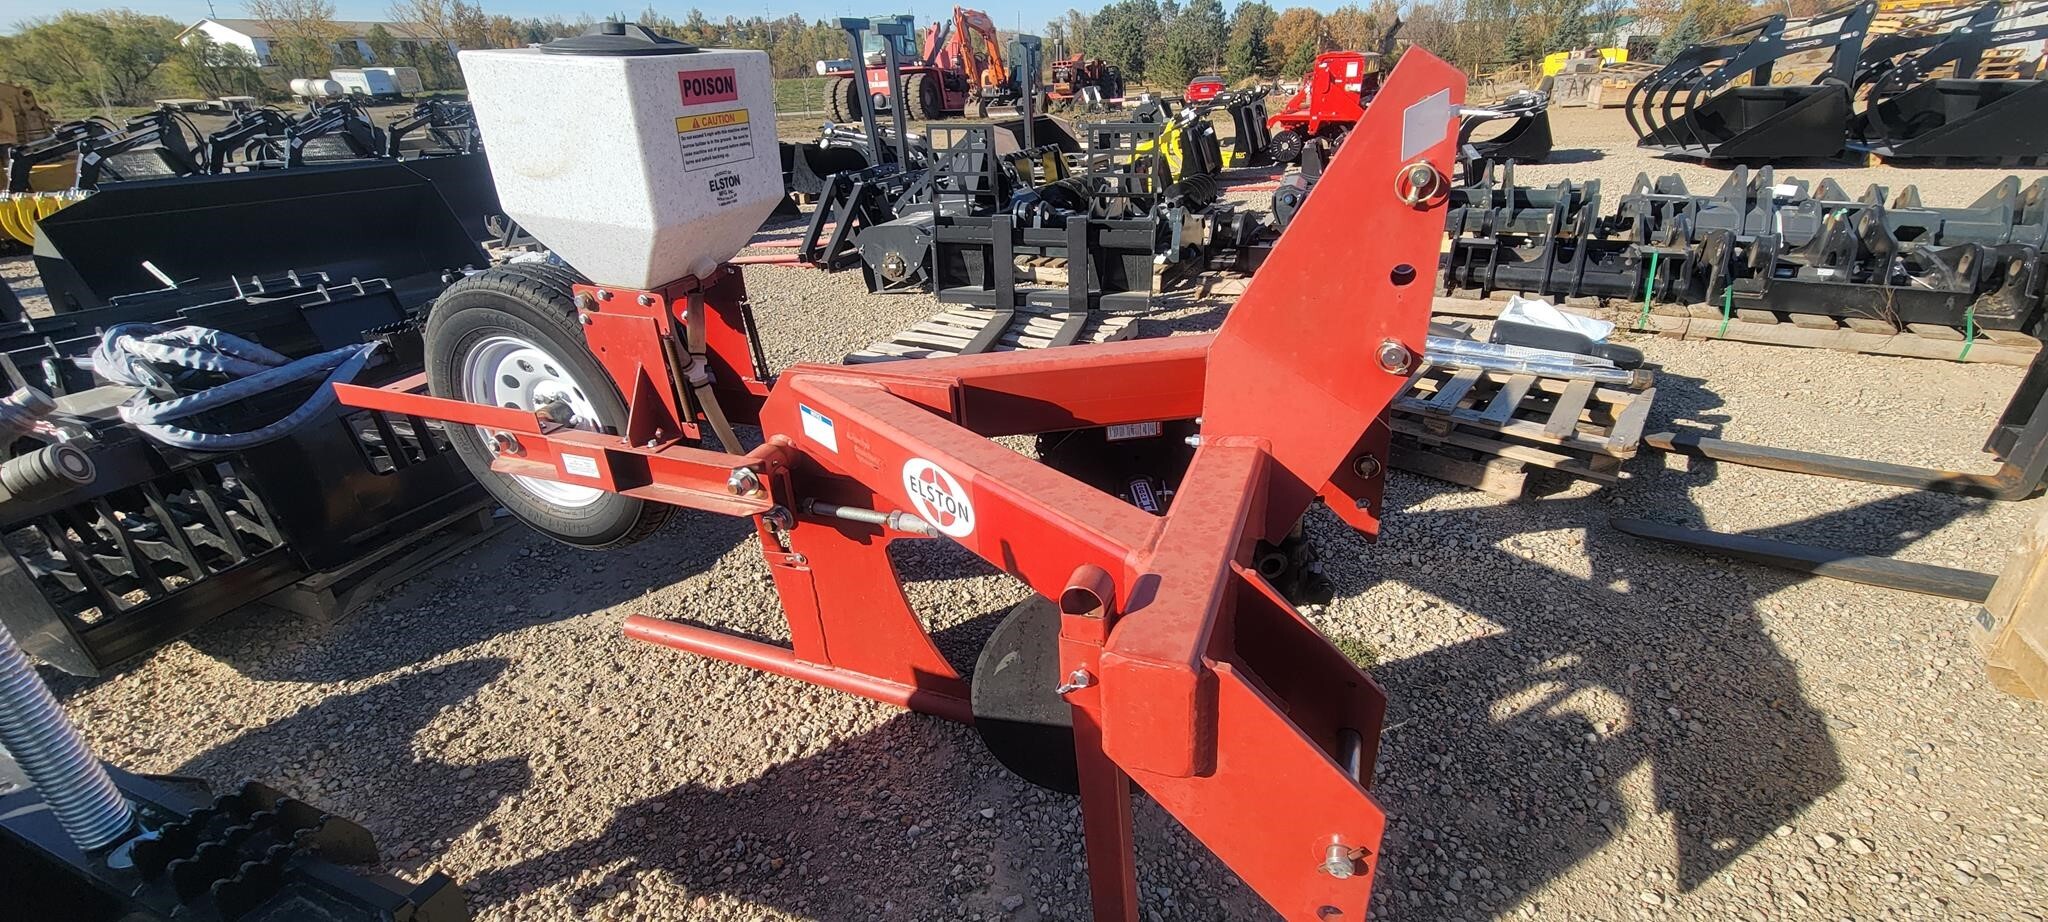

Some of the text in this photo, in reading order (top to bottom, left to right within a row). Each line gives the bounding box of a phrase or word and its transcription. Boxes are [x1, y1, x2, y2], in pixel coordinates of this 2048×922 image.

[683, 75, 734, 98] POISON
[701, 113, 736, 127] CAUTION
[709, 174, 741, 192] ELSTON
[909, 475, 969, 523] ELSTON
